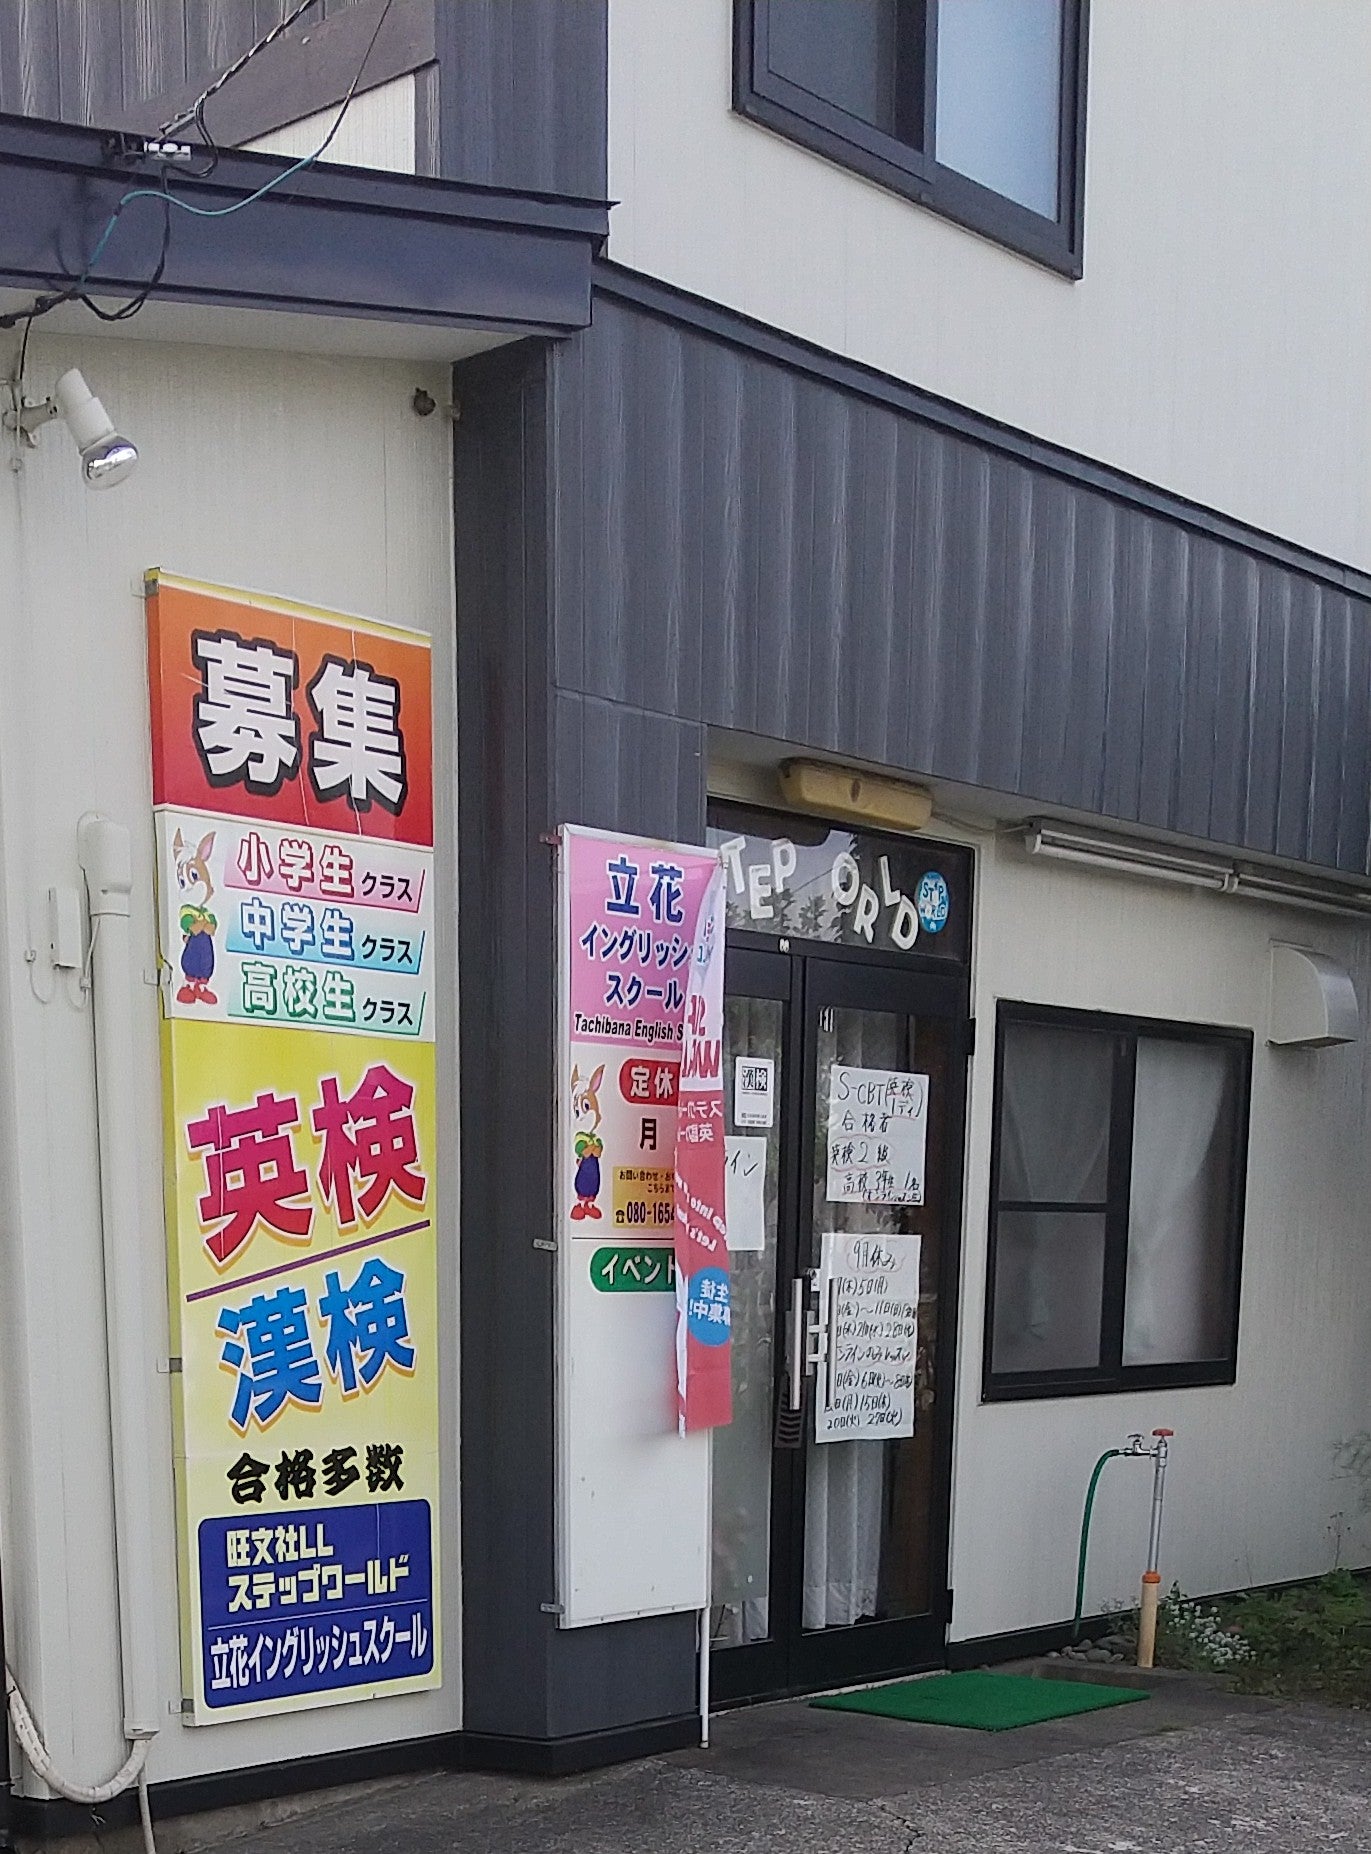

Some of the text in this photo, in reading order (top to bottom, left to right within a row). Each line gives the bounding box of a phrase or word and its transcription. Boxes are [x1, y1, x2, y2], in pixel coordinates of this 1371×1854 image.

[195, 631, 406, 812] 募集
[606, 856, 684, 923] 立花
[581, 924, 693, 968] イングリッシ
[605, 974, 684, 1010] スクール
[574, 1013, 684, 1044] Tachibana English S
[630, 1065, 674, 1099] 定休
[640, 1118, 657, 1151] 月
[186, 1065, 427, 1263] 英検
[619, 1170, 674, 1181] お問い合わせ・お
[601, 1253, 675, 1286] イベント
[215, 1257, 415, 1430] 漢検
[227, 1443, 405, 1504] 合格多数
[226, 1522, 334, 1570] 旺文社LL
[227, 1555, 410, 1612] ステップワールド
[210, 1617, 427, 1689] 立花イングリッシュスクール
